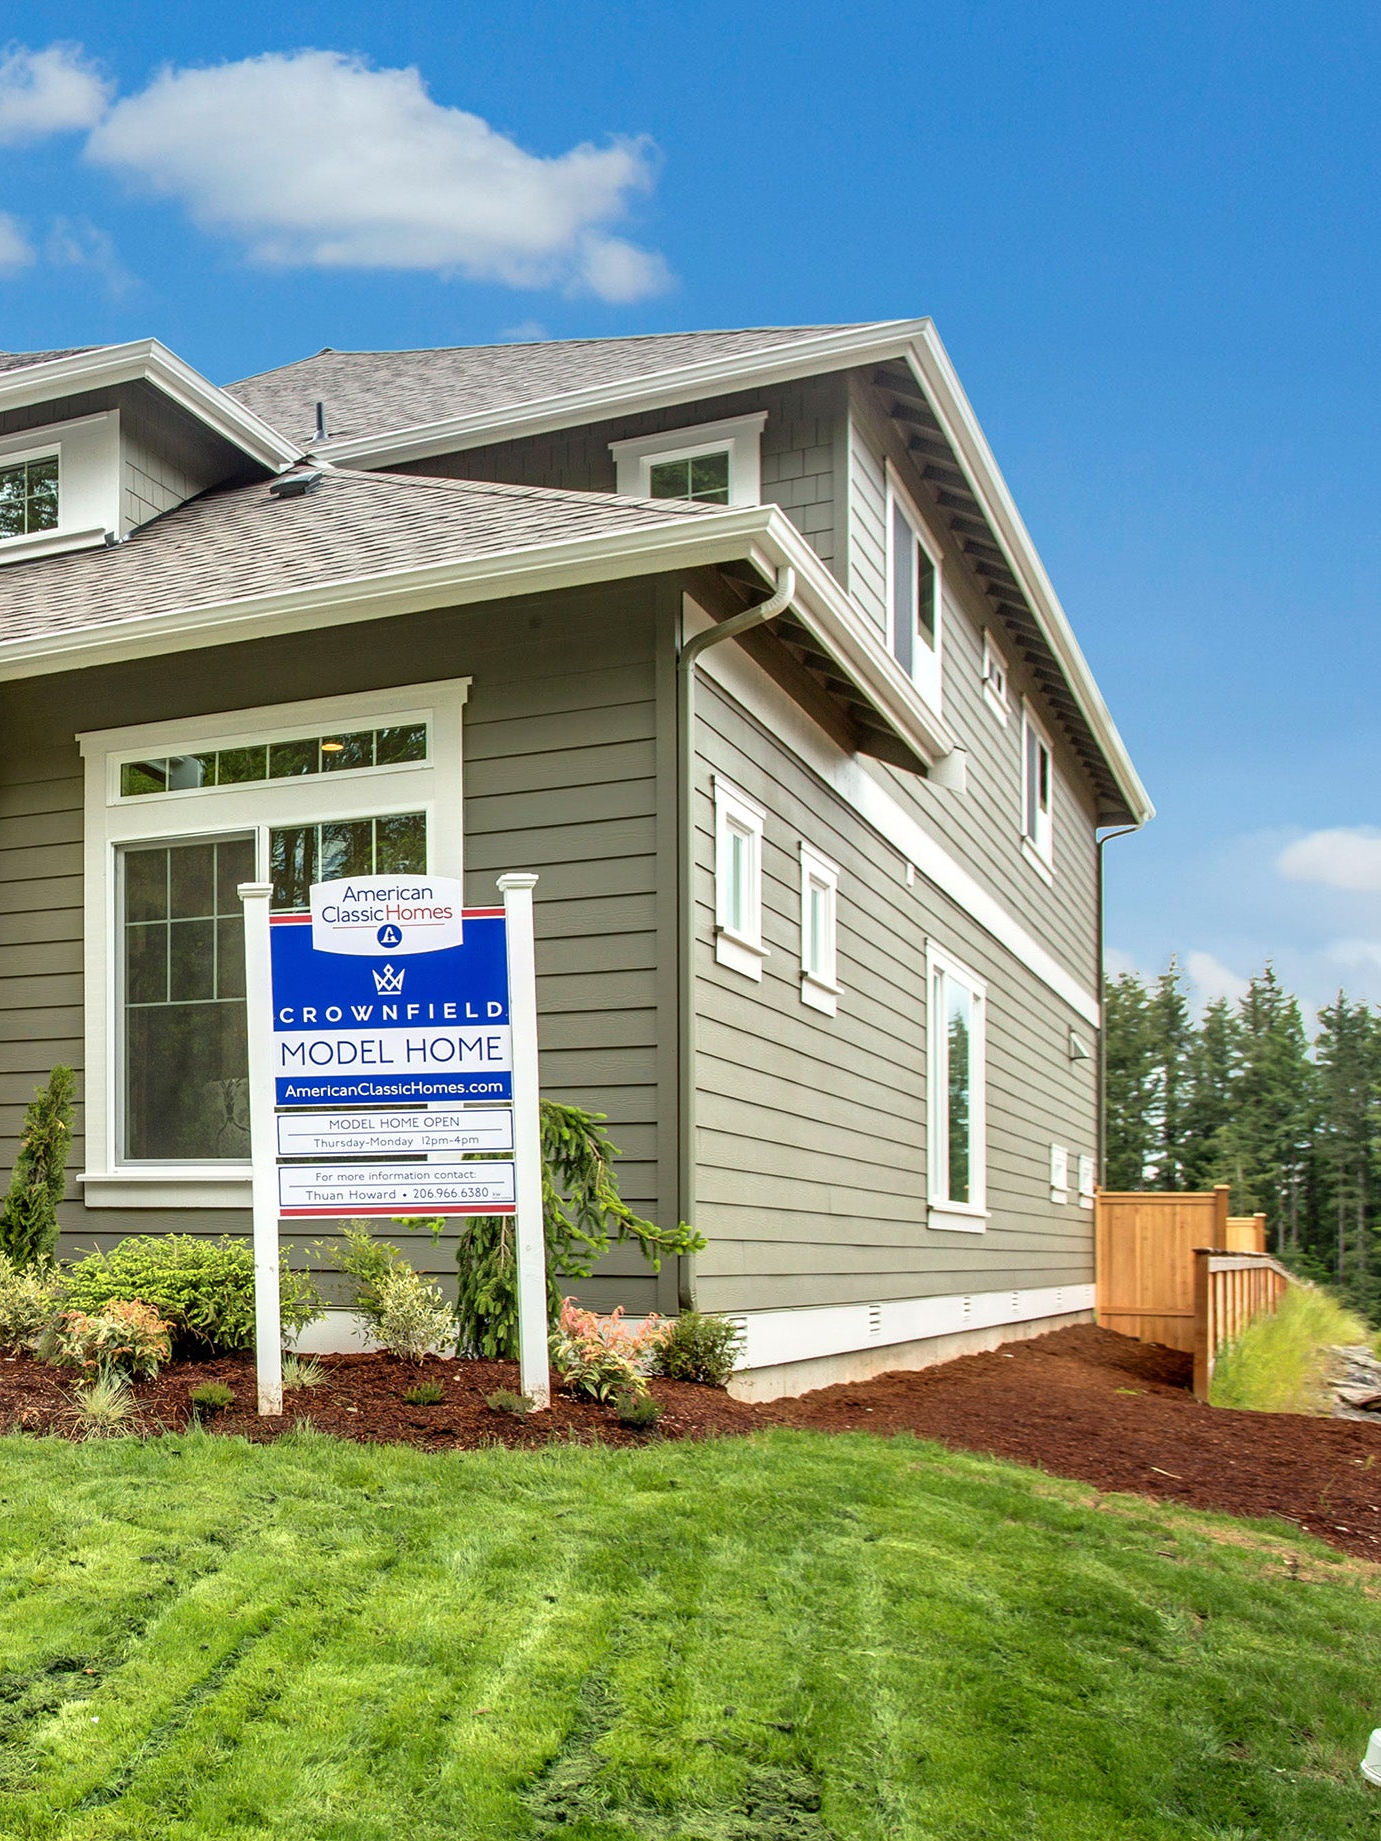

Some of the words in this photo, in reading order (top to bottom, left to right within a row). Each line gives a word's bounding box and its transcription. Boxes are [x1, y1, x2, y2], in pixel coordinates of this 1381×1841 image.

[342, 885, 433, 902] American
[322, 904, 453, 923] ClassicHomes
[279, 1001, 503, 1024] CROWNFIELD
[281, 1040, 394, 1066] MODEL
[406, 1036, 503, 1063] HOME
[285, 1082, 503, 1098] AmericanClassicHomes.com
[329, 1118, 375, 1130] MODEL
[380, 1117, 419, 1128] HOME
[423, 1116, 460, 1127] OPEN
[314, 1136, 414, 1149] Thursday-Monday
[421, 1135, 480, 1147] 12pm-4pm
[316, 1171, 333, 1182] For
[368, 1171, 430, 1181] information
[434, 1170, 477, 1179] contact:
[306, 1189, 344, 1201] Thuan
[349, 1188, 396, 1200] Howard
[413, 1187, 489, 1199] 206.966.6380
